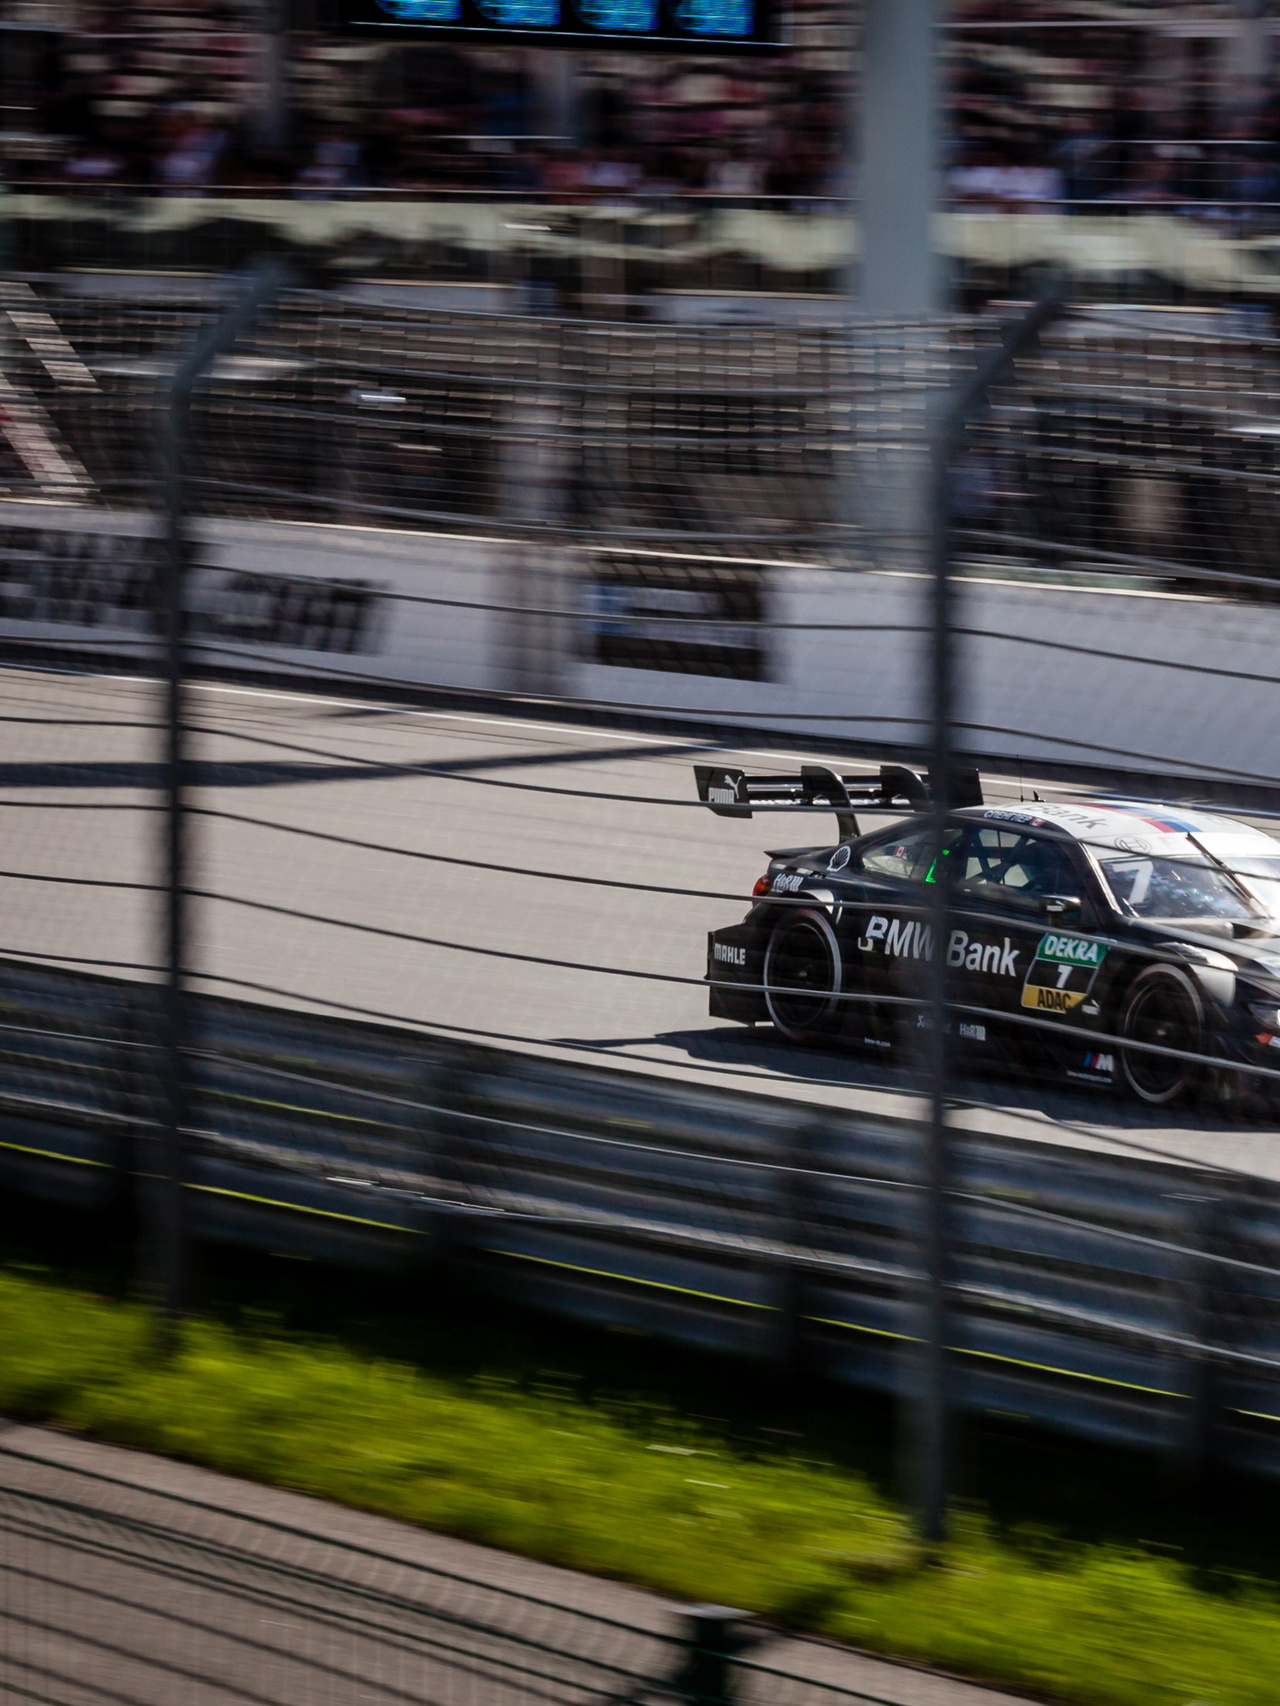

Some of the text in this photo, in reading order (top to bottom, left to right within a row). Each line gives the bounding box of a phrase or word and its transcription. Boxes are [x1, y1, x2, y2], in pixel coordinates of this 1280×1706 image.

[1112, 860, 1154, 904] 7
[714, 942, 746, 965] MAHLE
[858, 915, 1020, 977] BMW Bank
[1044, 935, 1098, 962] DEKRA
[1037, 988, 1072, 1012] ADAC
[1095, 1053, 1115, 1072] M
